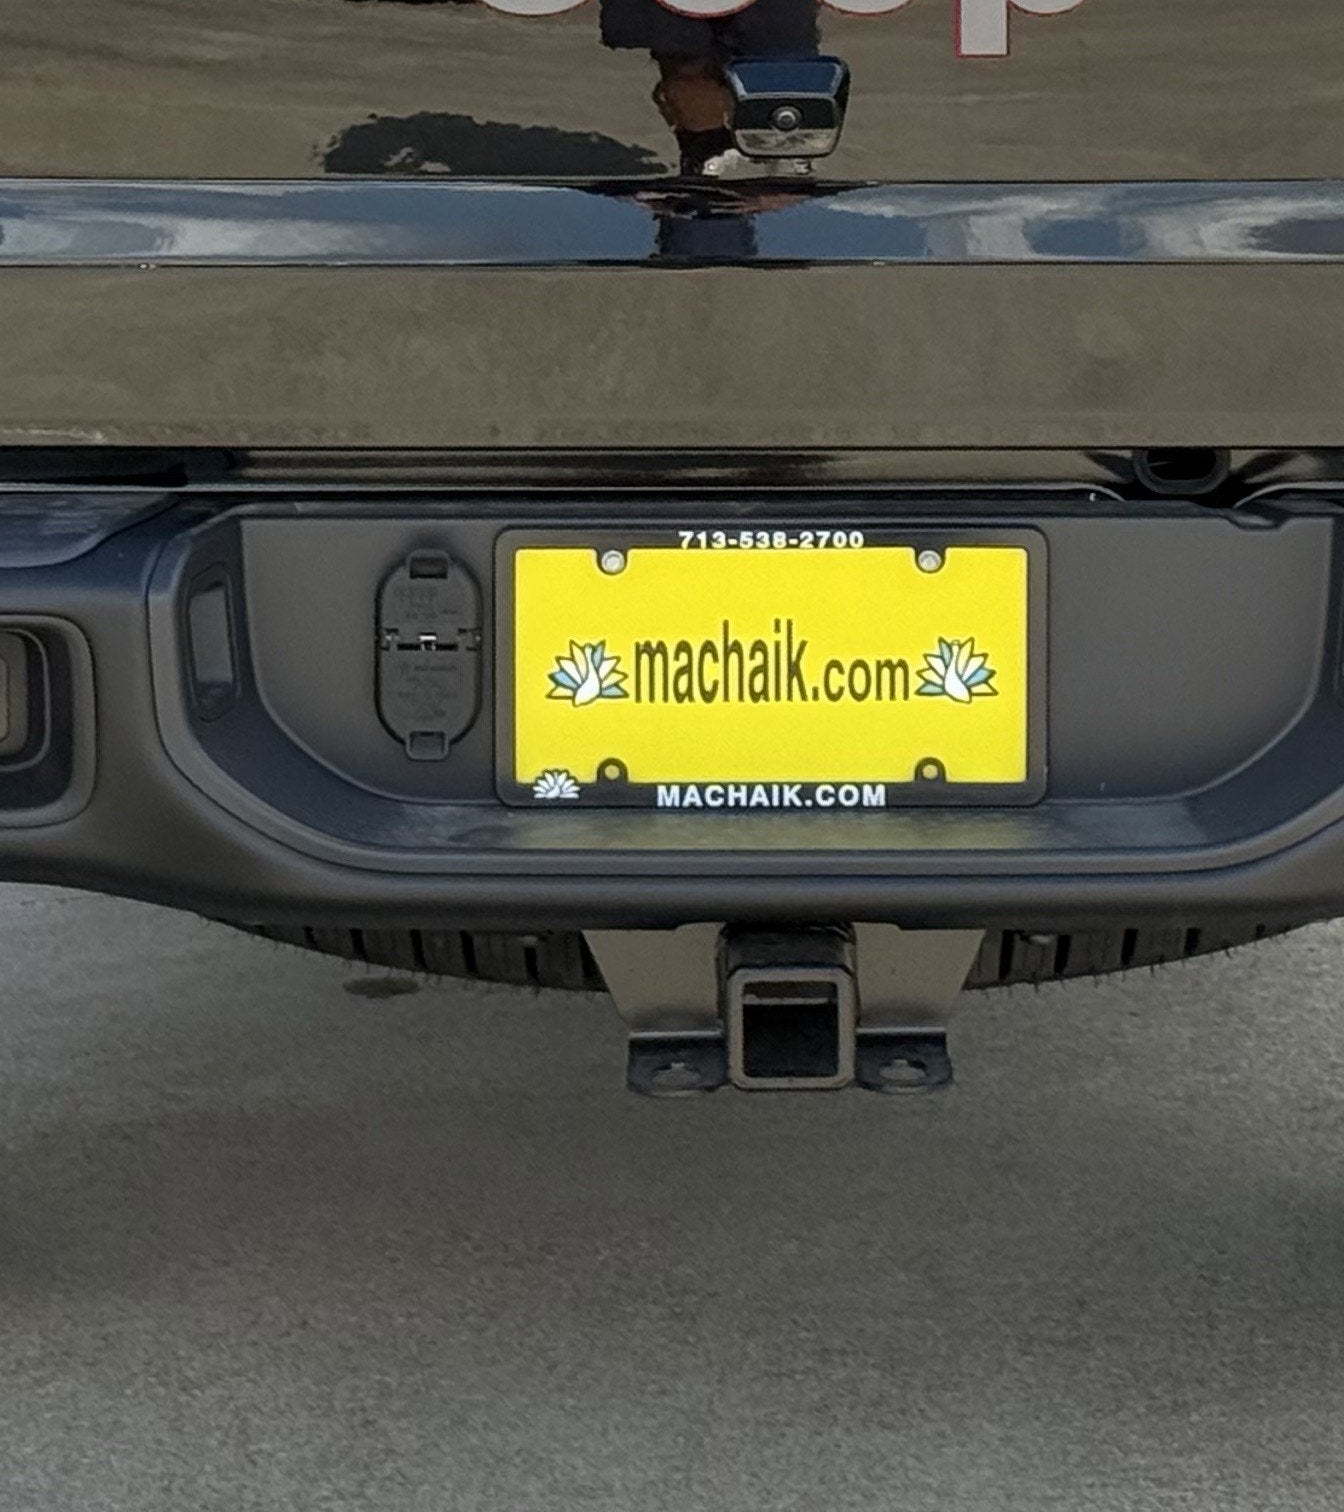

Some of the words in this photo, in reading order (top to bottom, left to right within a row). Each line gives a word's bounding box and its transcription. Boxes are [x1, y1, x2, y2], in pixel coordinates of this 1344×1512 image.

[678, 530, 865, 549] 713-538-2700
[634, 617, 910, 704] machaik.com
[656, 784, 887, 808] MACHAIK.COM
